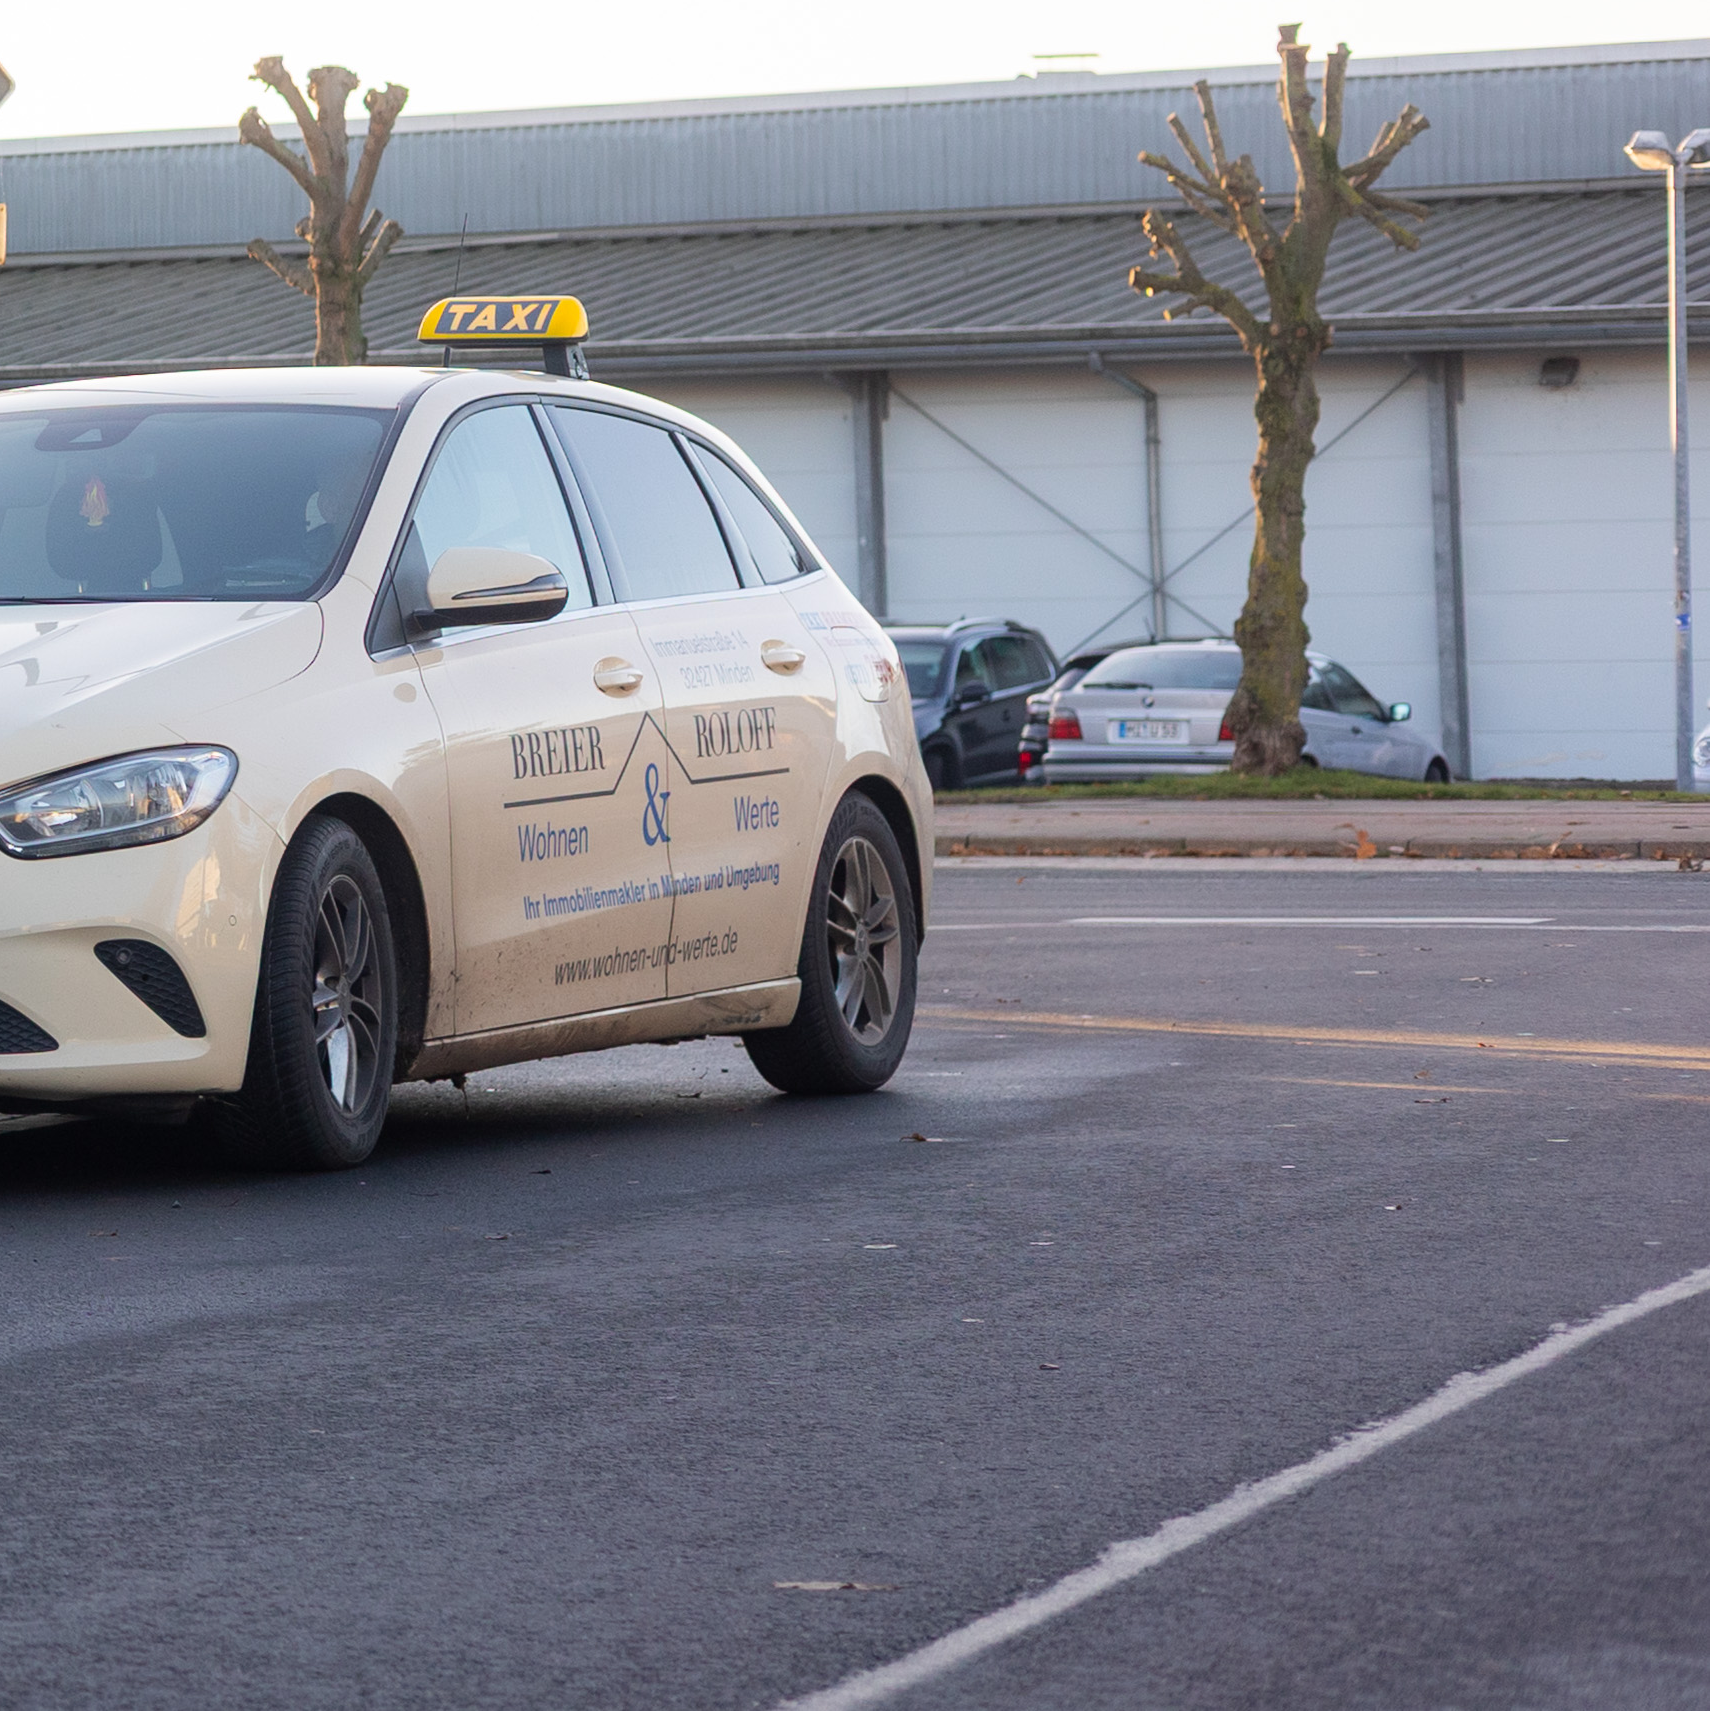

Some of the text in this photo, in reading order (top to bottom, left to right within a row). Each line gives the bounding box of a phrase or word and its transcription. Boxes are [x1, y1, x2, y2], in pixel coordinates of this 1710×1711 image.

[447, 303, 553, 332] TAXI
[712, 661, 756, 685] Minden
[508, 706, 777, 779] BREIER ROLOFF
[518, 795, 780, 863] Wohnen Werte
[642, 762, 671, 846] &
[523, 860, 780, 921] Ihr Immobilienmakler in Minden und Umgebung
[554, 925, 739, 986] www.wohnen-und-werte.de
